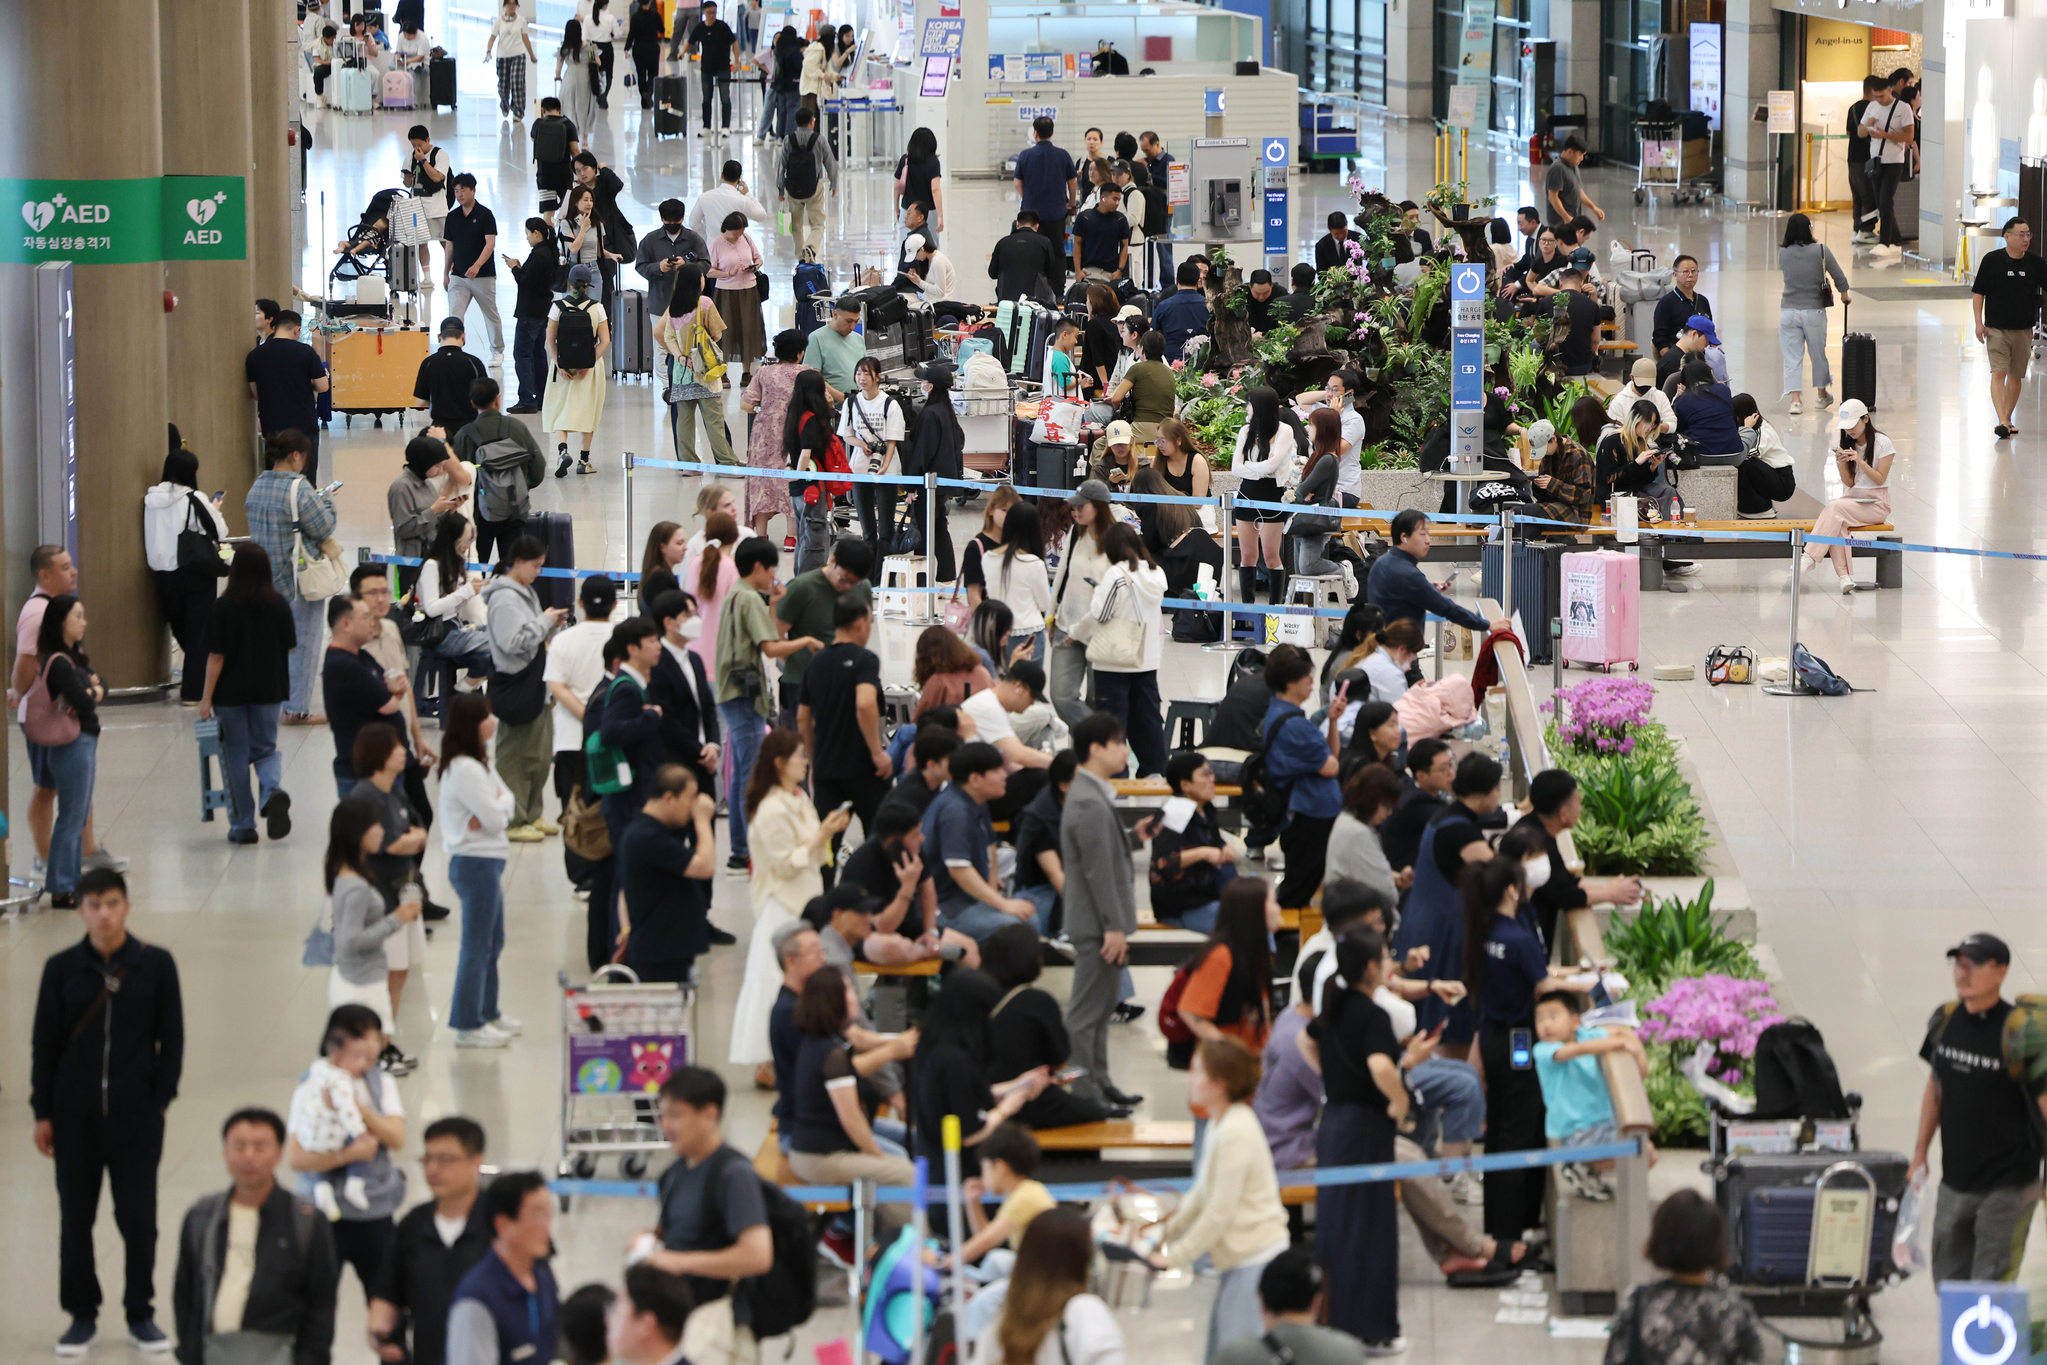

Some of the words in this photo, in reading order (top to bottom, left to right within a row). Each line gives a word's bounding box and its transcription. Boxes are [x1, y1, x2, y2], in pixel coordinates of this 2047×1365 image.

[928, 21, 962, 30] KOREA
[1815, 37, 1863, 46] Angel-in-us
[923, 45, 946, 53] eSIM
[61, 204, 110, 224] AED
[183, 230, 222, 244] AED
[23, 236, 111, 250] 자동심장충격기
[1314, 506, 1340, 515] SECURITY
[1844, 538, 1872, 547] SECURITY
[1286, 607, 1318, 616] SECURITY
